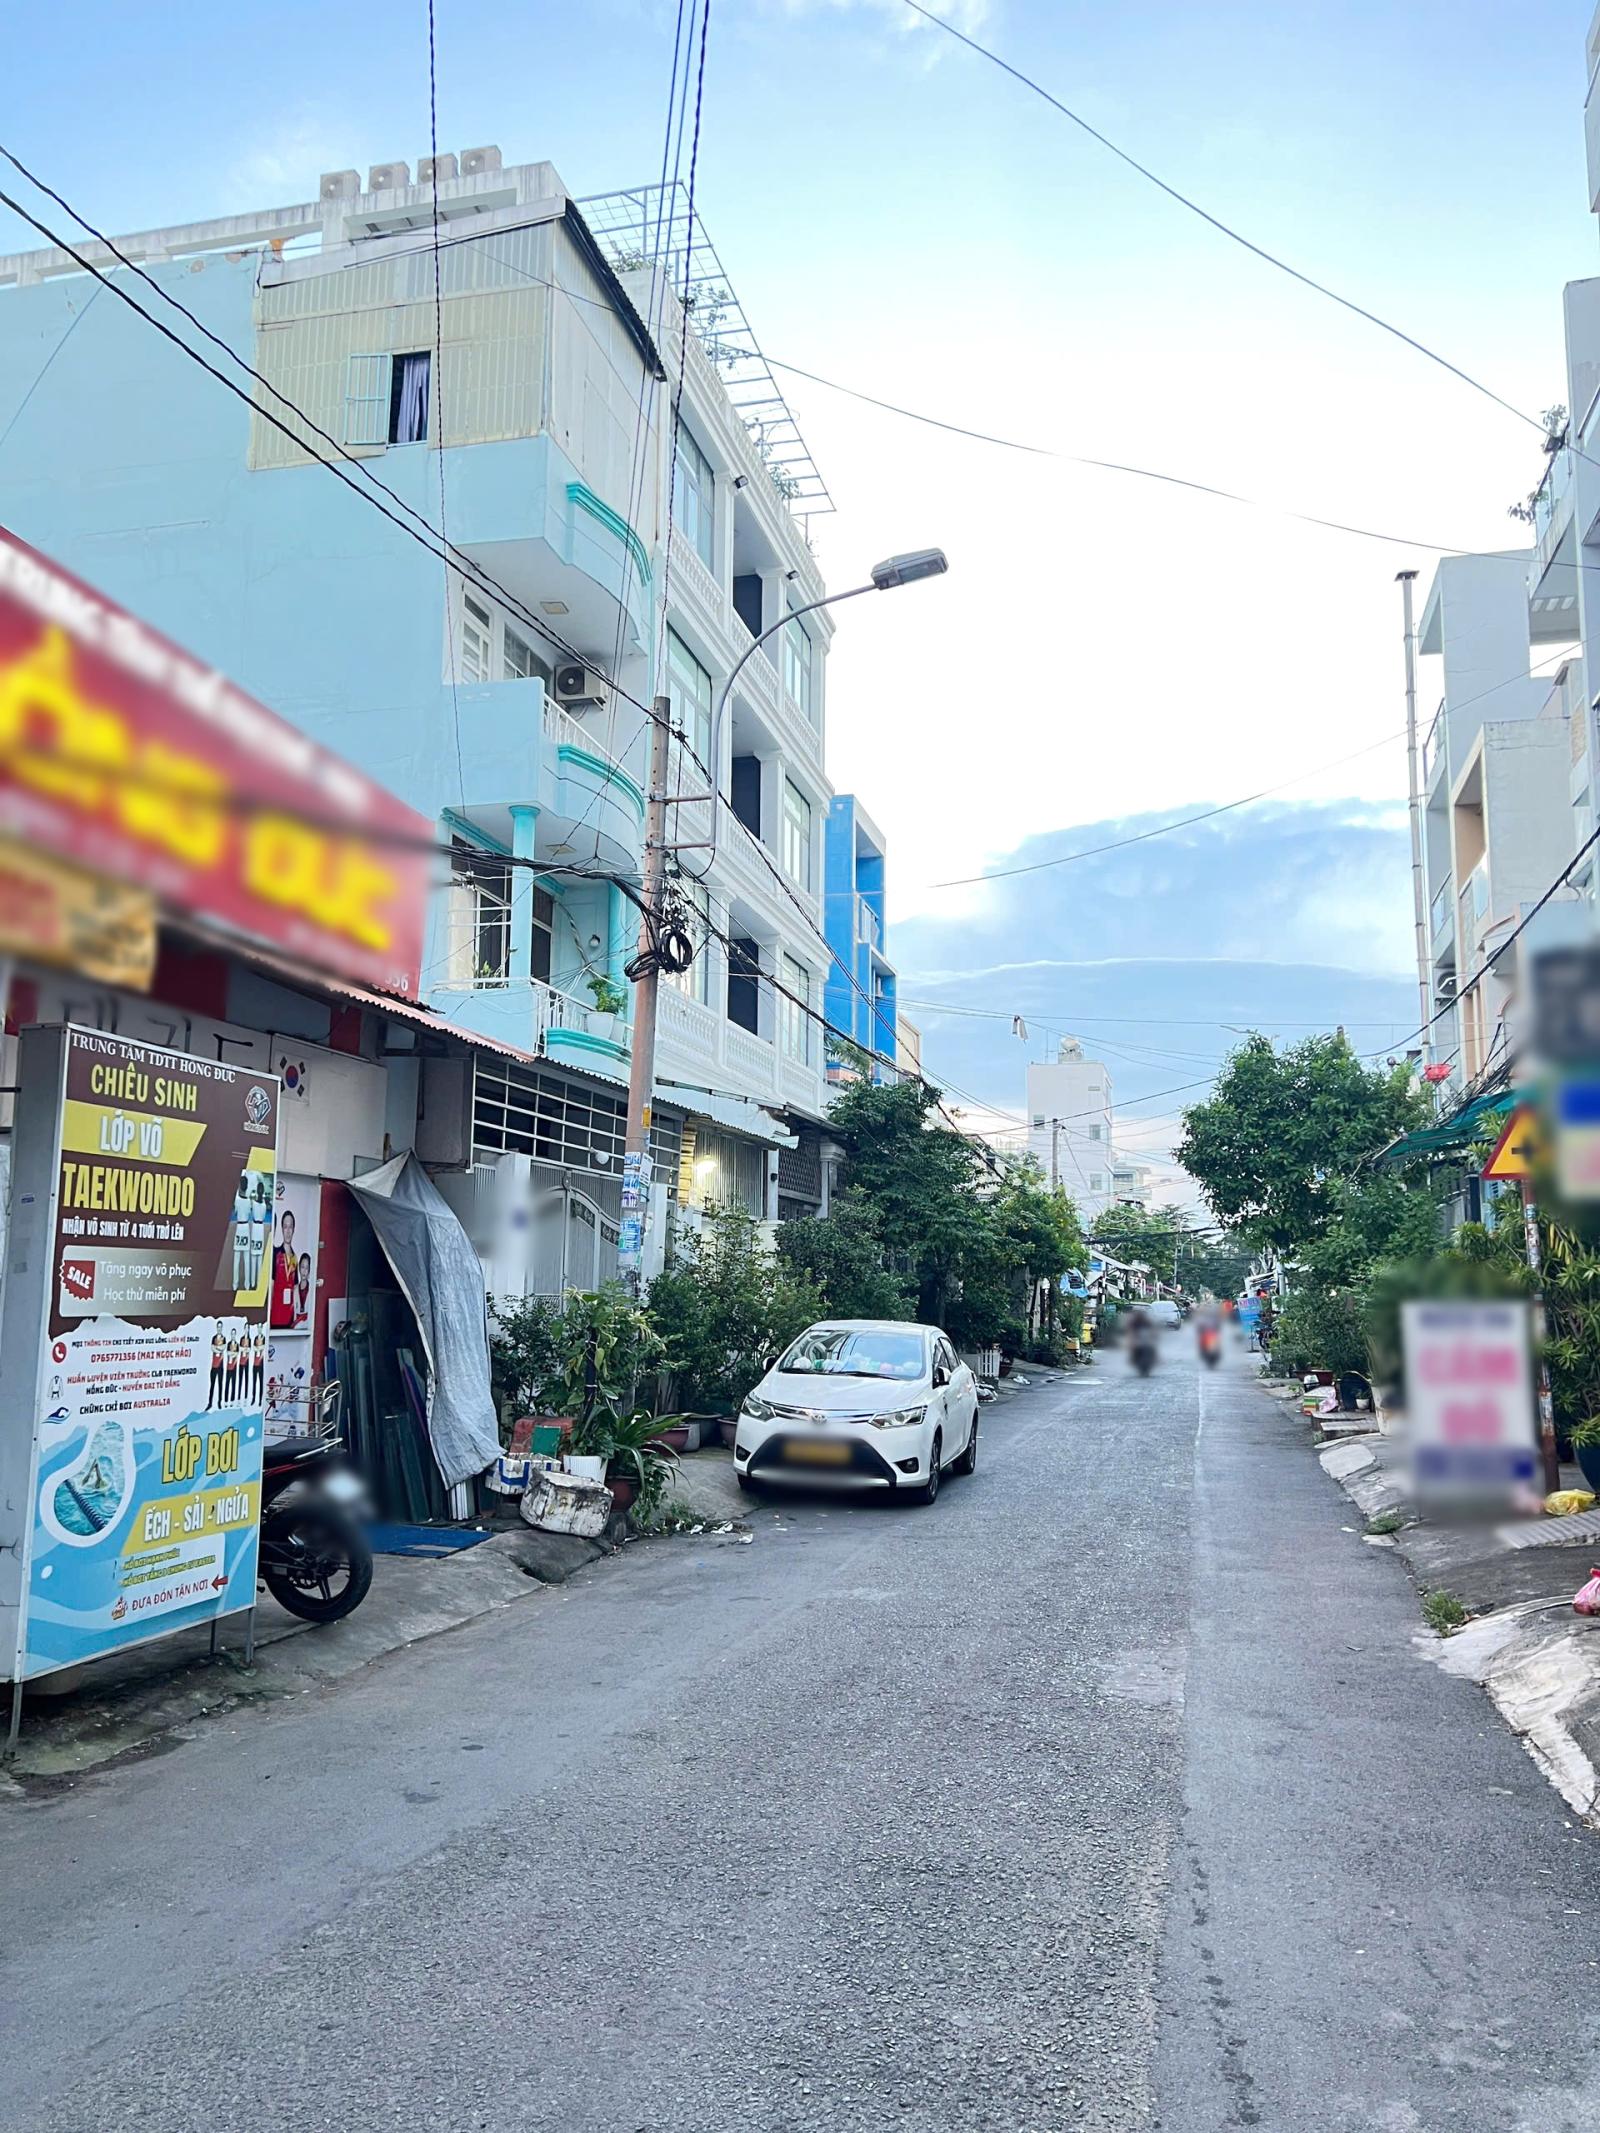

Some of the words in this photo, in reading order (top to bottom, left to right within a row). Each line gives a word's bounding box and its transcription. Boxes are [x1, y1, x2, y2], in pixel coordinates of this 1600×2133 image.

[71, 1032, 117, 1056] TRUNG
[119, 1044, 145, 1063] TÂM
[148, 1051, 178, 1070] TDTT
[91, 1062, 149, 1103] CHIÊU
[154, 1077, 198, 1112] SINH
[100, 1109, 135, 1154] LỚP
[140, 1116, 163, 1158] VÕ
[62, 1162, 195, 1218] TAEKWONDO
[62, 1215, 86, 1238] NHẬN
[87, 1217, 98, 1236] VÕ
[99, 1221, 118, 1237] SINH
[119, 1219, 131, 1238] TỪ
[131, 1222, 138, 1239] 4
[170, 1222, 185, 1241] LÊN
[66, 1265, 93, 1290] SALE
[100, 1260, 126, 1279] Tặng
[128, 1264, 153, 1279] ngay
[155, 1263, 167, 1276] võ
[169, 1263, 192, 1279] phục
[103, 1287, 124, 1304] Học
[126, 1287, 144, 1301] thử
[145, 1285, 169, 1301] miễn
[170, 1286, 187, 1305] phí
[90, 1352, 136, 1364] 0765771356
[155, 1349, 174, 1362] NGỌC
[133, 1398, 171, 1409] AUSTRALIA
[161, 1424, 203, 1485] LỚP
[206, 1426, 240, 1476] BƠI
[144, 1506, 172, 1542] ẾCH
[183, 1495, 206, 1533] SẢI
[216, 1486, 249, 1526] NGỬA
[132, 1595, 152, 1611] ĐƯA
[154, 1589, 172, 1605] ĐÓN
[175, 1583, 191, 1599] TẬN
[193, 1579, 208, 1592] NƠI
